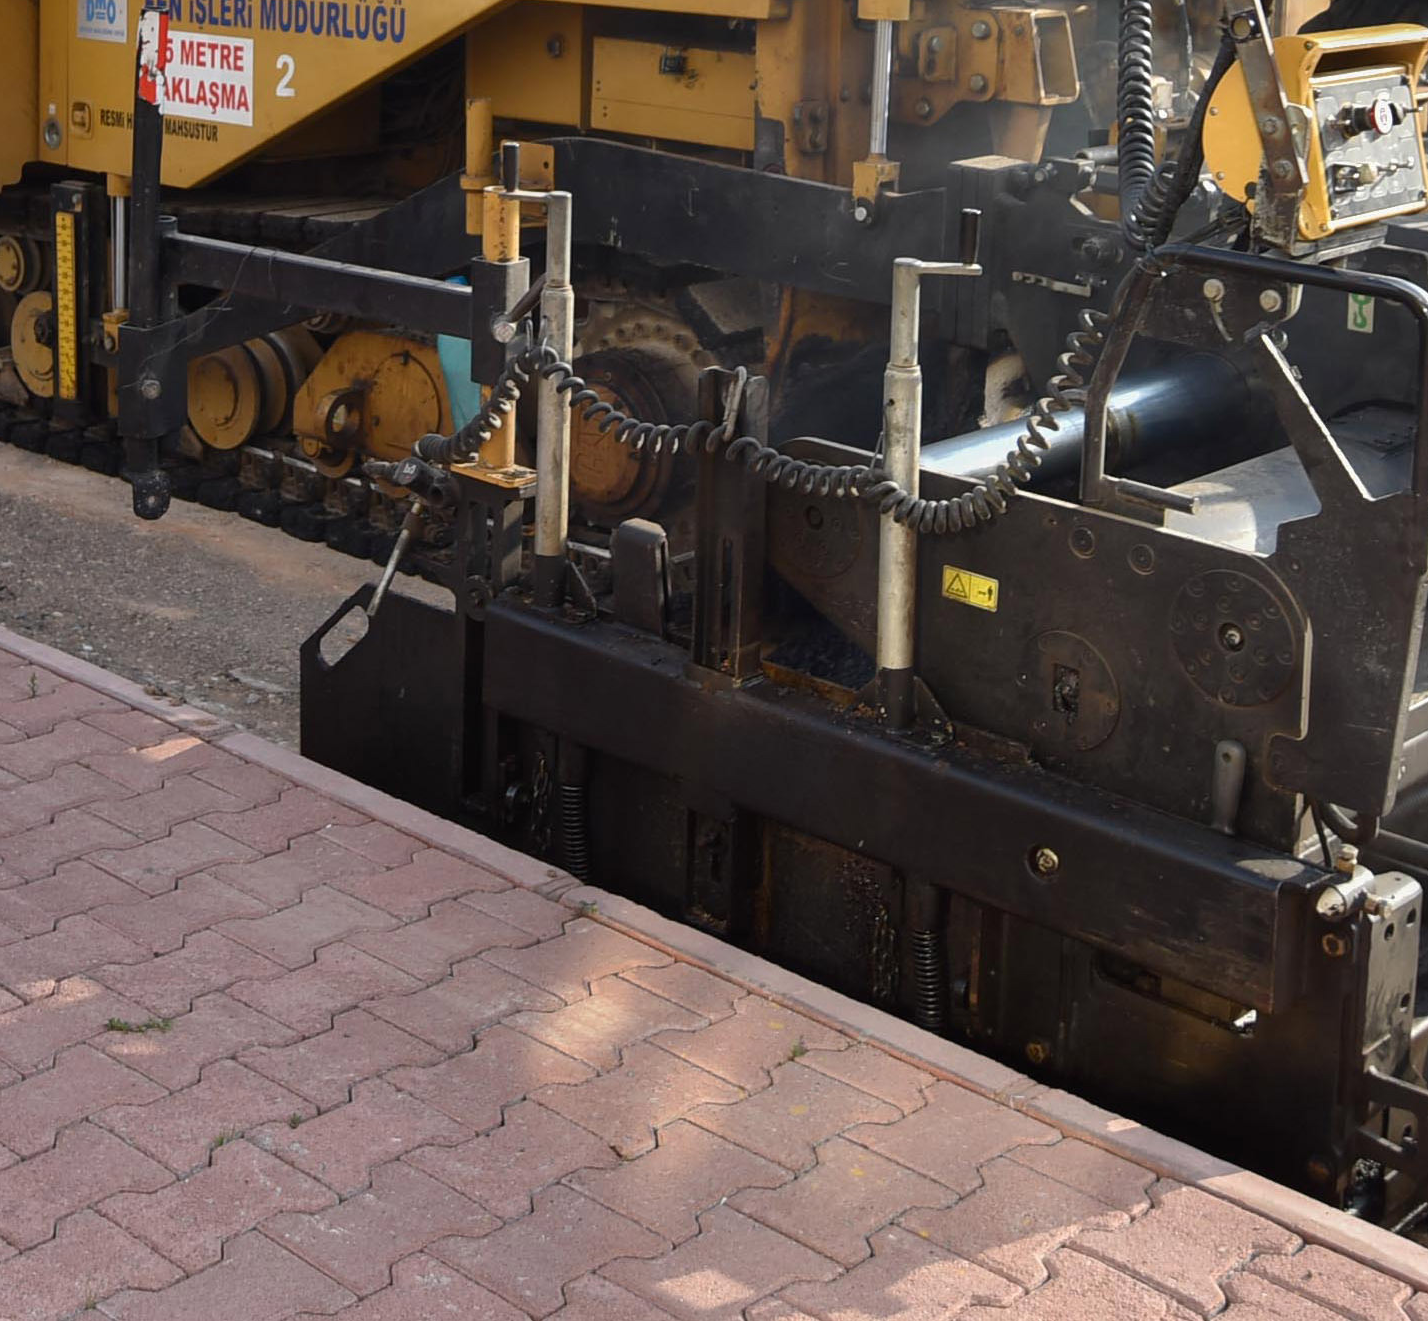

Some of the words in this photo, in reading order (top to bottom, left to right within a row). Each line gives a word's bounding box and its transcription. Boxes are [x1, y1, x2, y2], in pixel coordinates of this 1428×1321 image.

[180, 39, 244, 73] METRE
[275, 54, 296, 97] 2
[164, 77, 250, 115] AKLAŞMA
[165, 117, 219, 143] MAHSUSTUR
